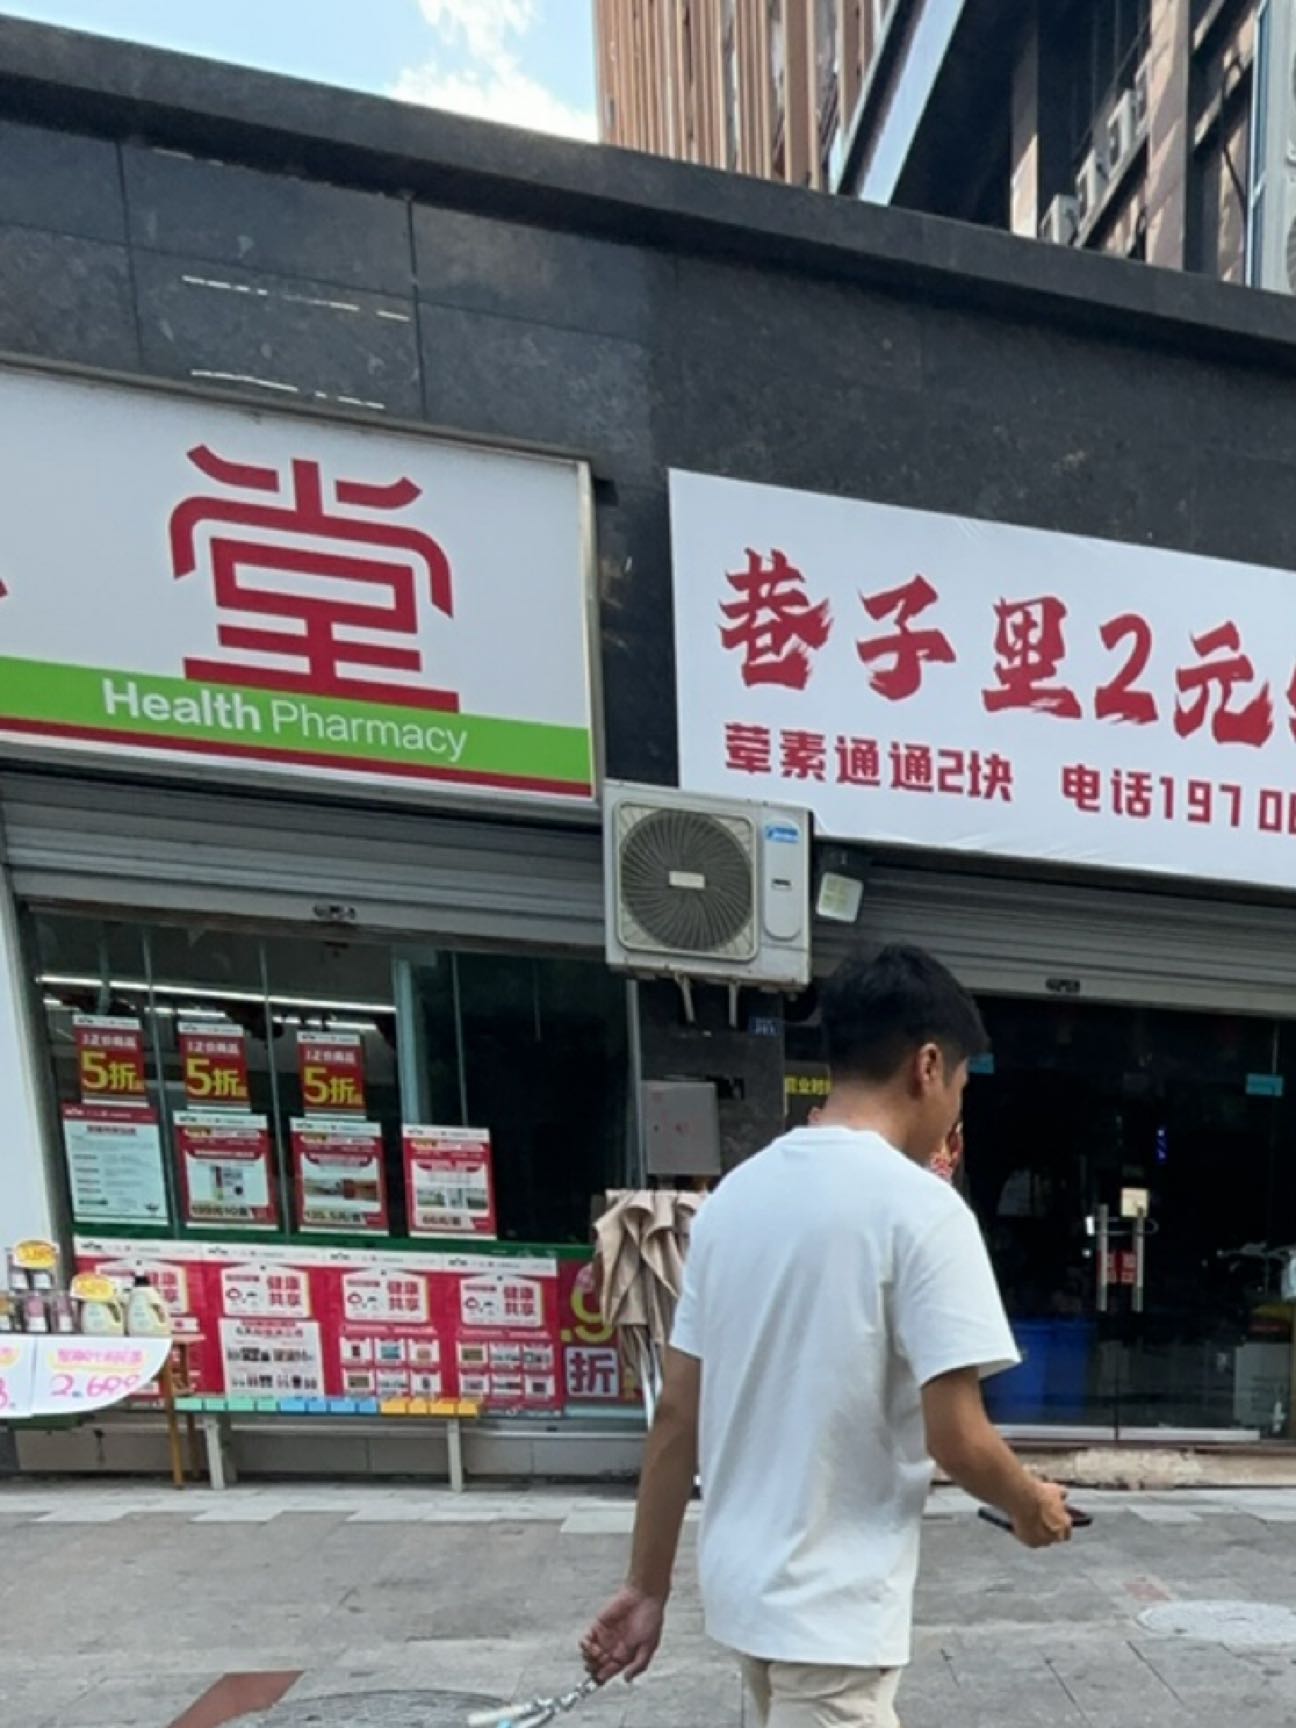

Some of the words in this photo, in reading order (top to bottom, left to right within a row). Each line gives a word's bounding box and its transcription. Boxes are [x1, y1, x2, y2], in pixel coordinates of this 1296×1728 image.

[167, 444, 461, 713] 堂
[101, 677, 262, 733] Health
[271, 699, 467, 763] Pharmacy
[724, 722, 1014, 802] 荤素通通2块
